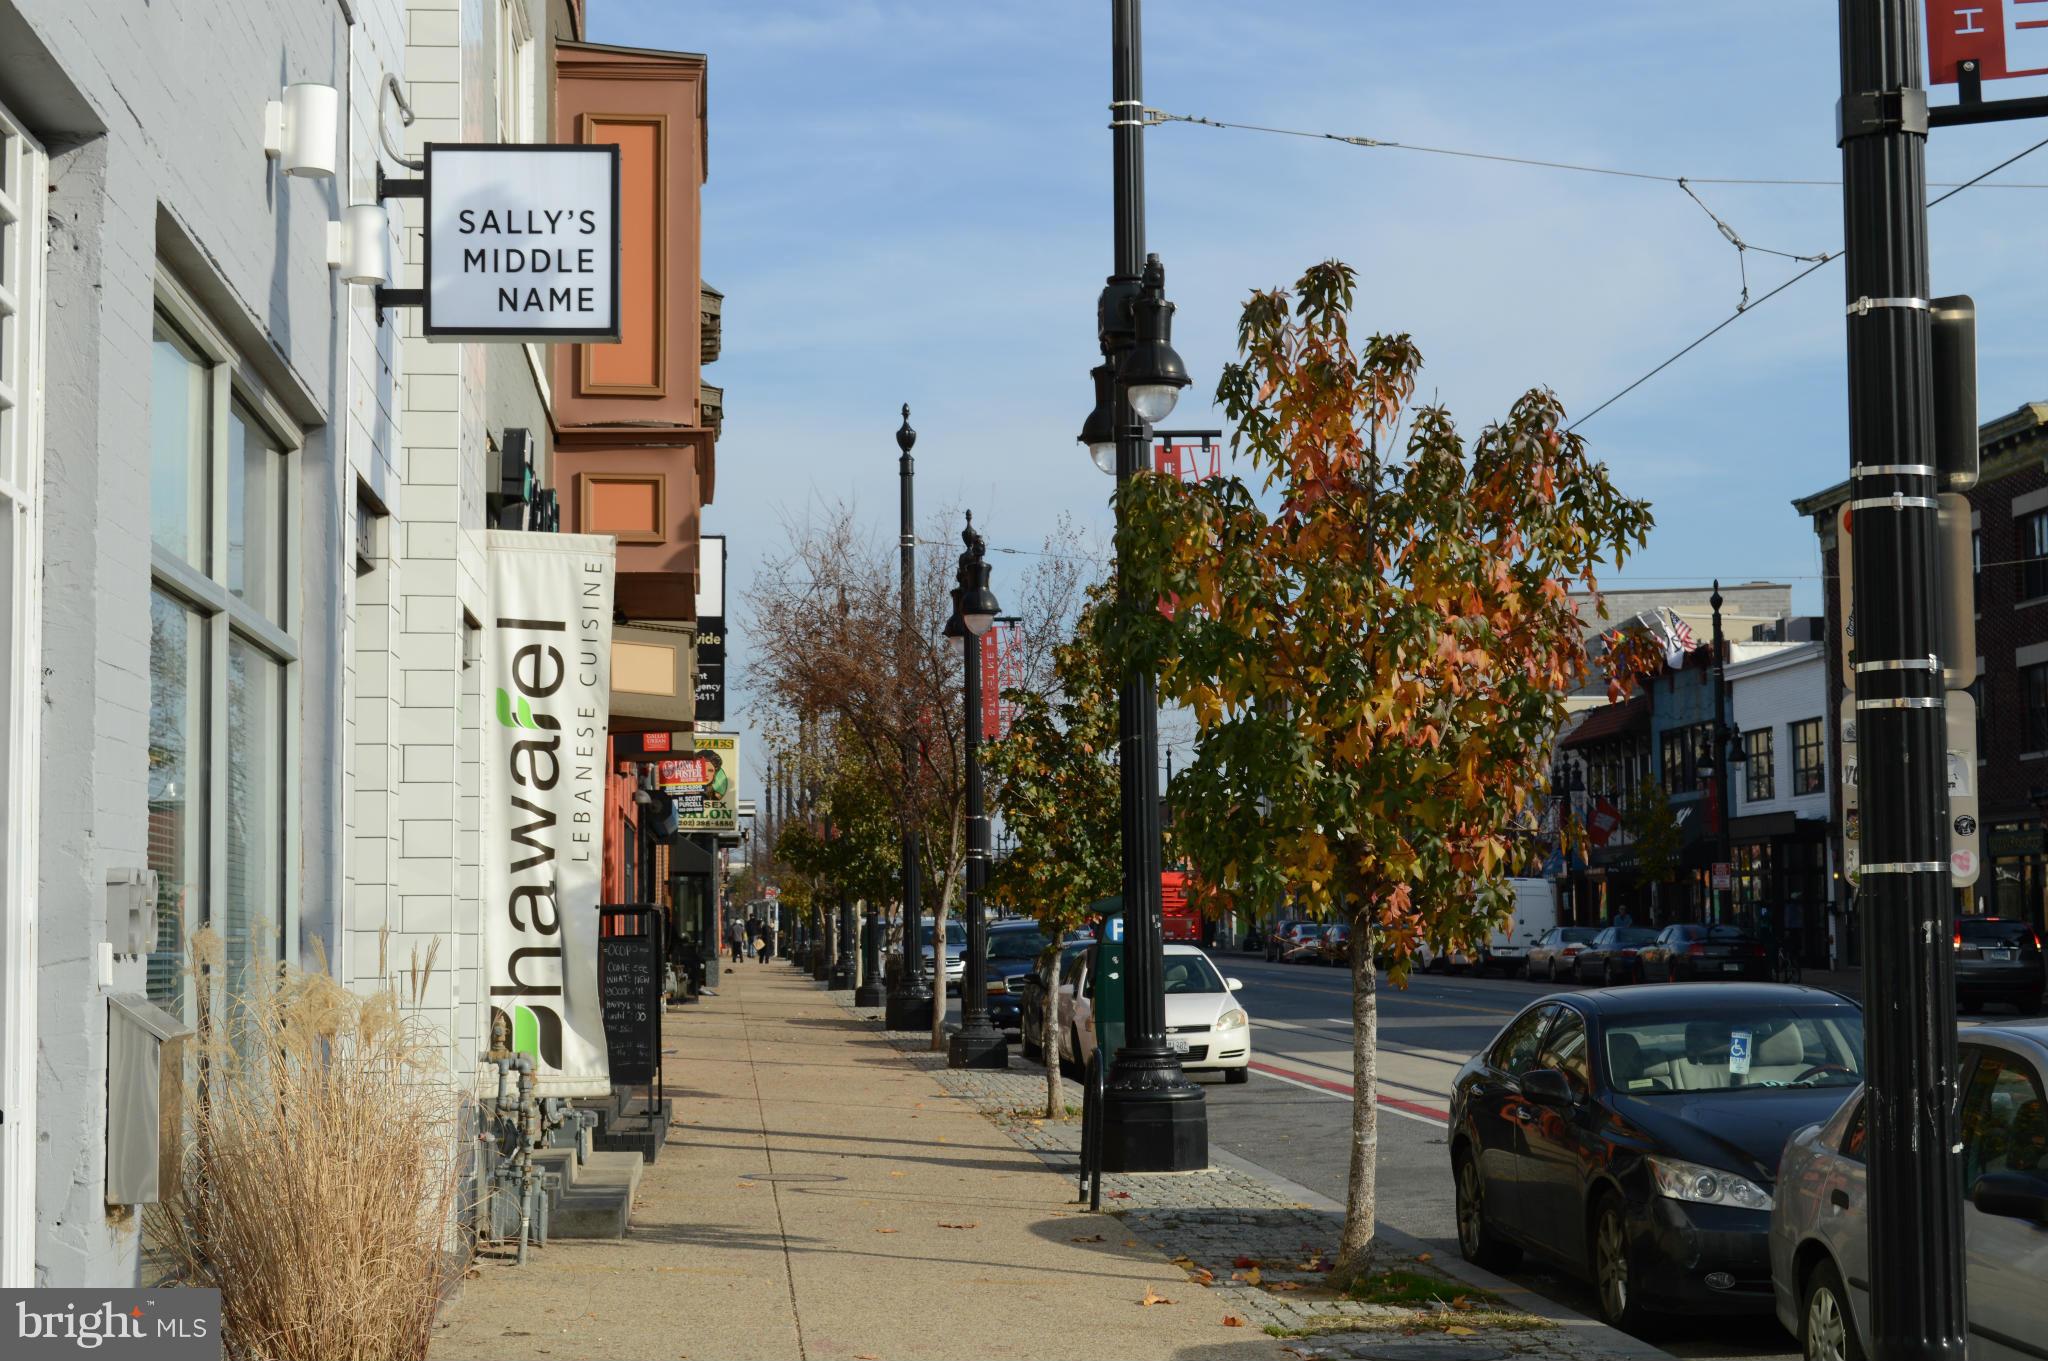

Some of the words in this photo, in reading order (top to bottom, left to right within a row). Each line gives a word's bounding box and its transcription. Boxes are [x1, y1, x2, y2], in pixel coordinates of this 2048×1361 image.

[459, 209, 596, 235] SALLY'S
[464, 248, 594, 273] MIDDLE
[499, 287, 594, 312] NAME
[579, 561, 604, 688] CUISINE
[674, 760, 694, 769] LONG
[674, 769, 702, 778] FOSTER
[571, 707, 596, 863] LEBANESE
